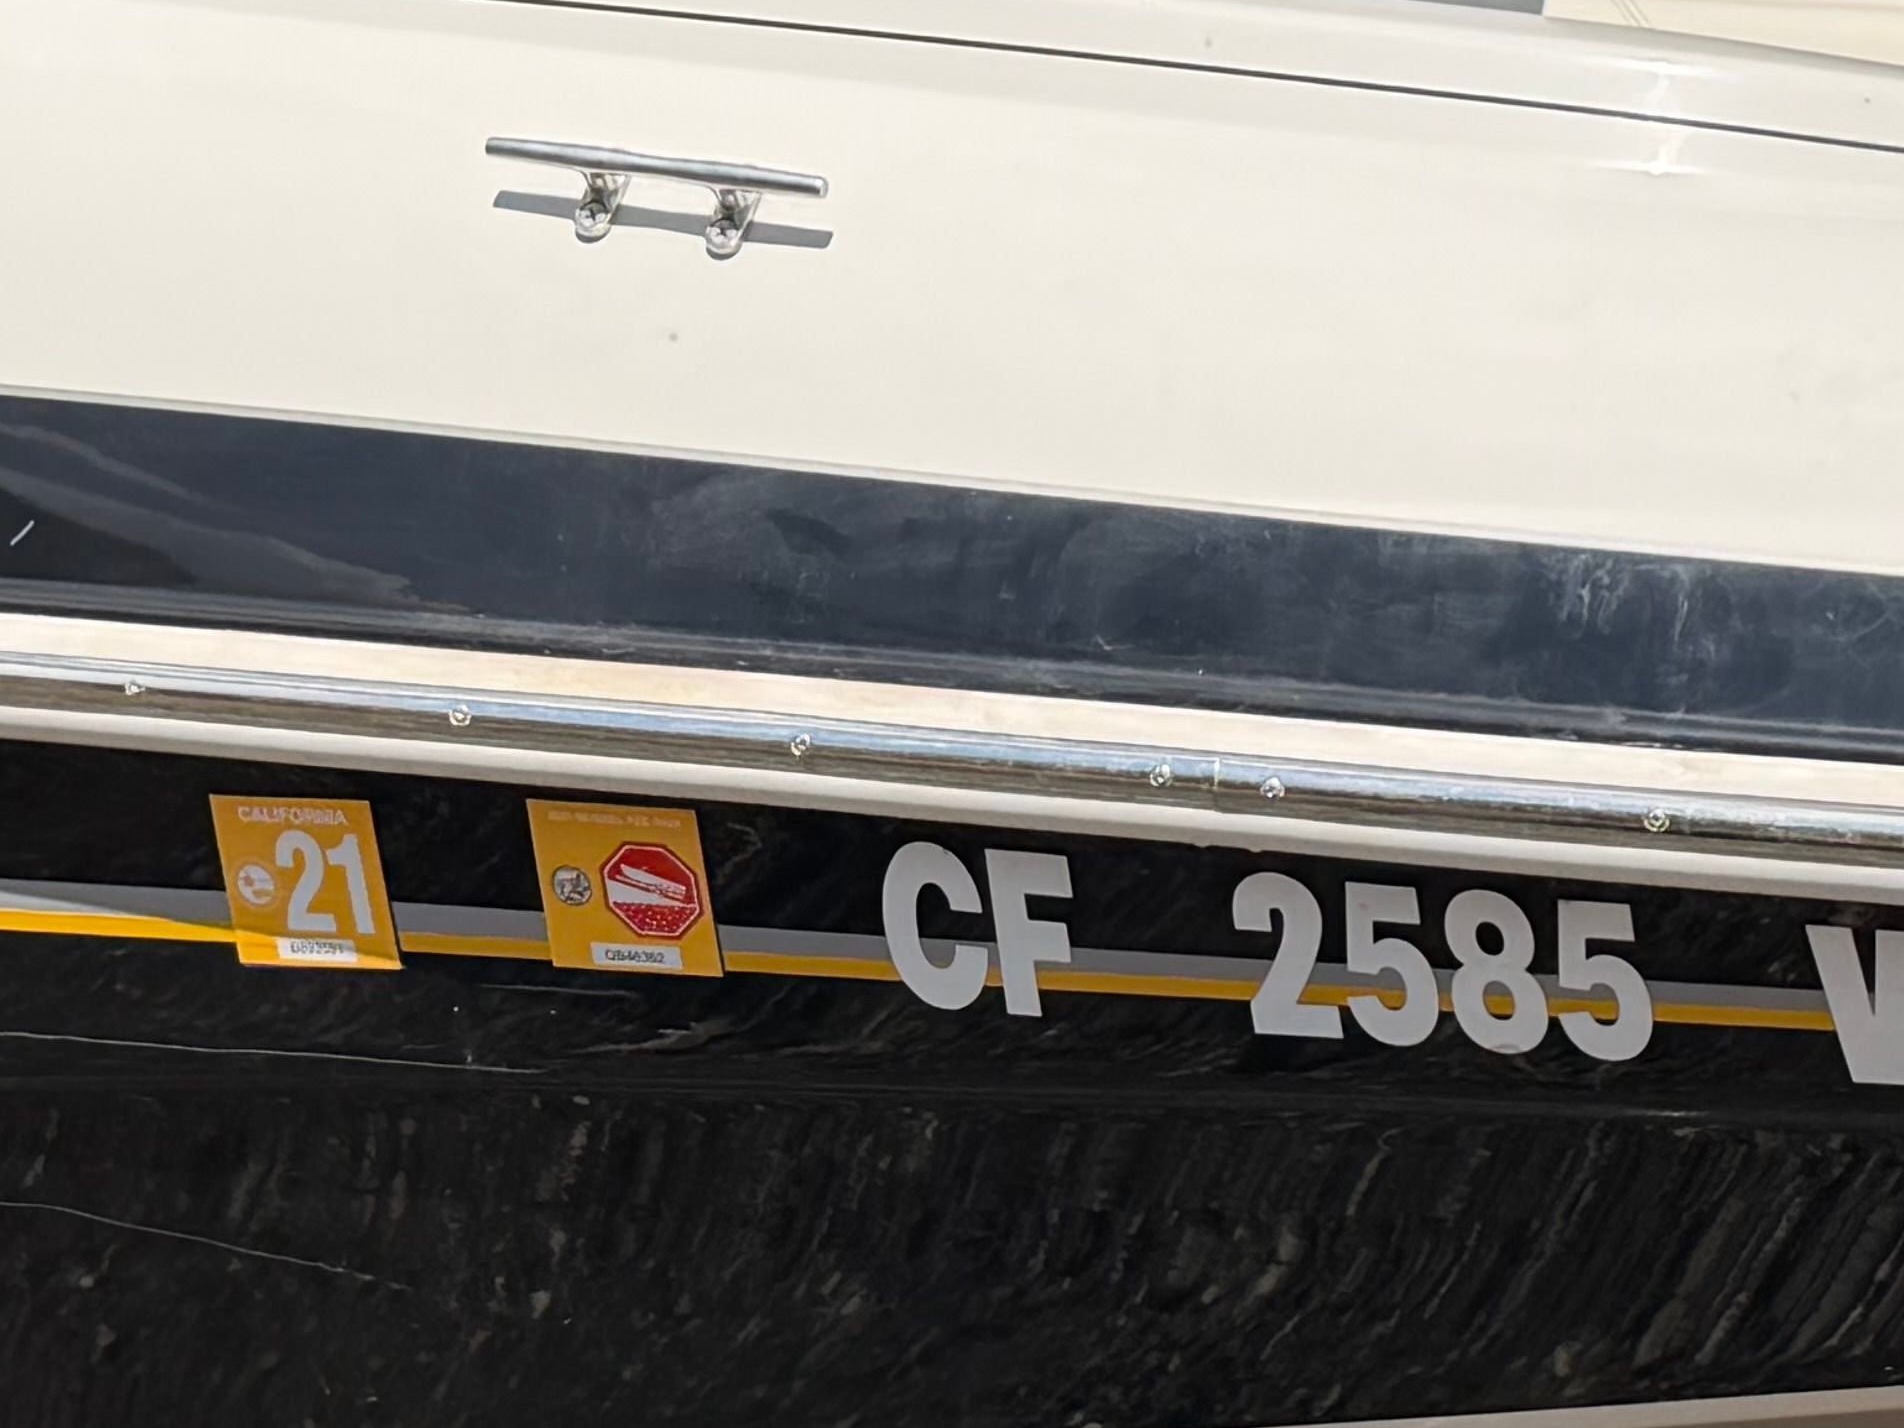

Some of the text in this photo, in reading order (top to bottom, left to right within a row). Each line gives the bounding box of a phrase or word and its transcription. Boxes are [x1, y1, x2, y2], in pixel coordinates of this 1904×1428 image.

[276, 829, 375, 935] 21
[883, 842, 1073, 1016] CF
[1232, 873, 1652, 1060] 2585
